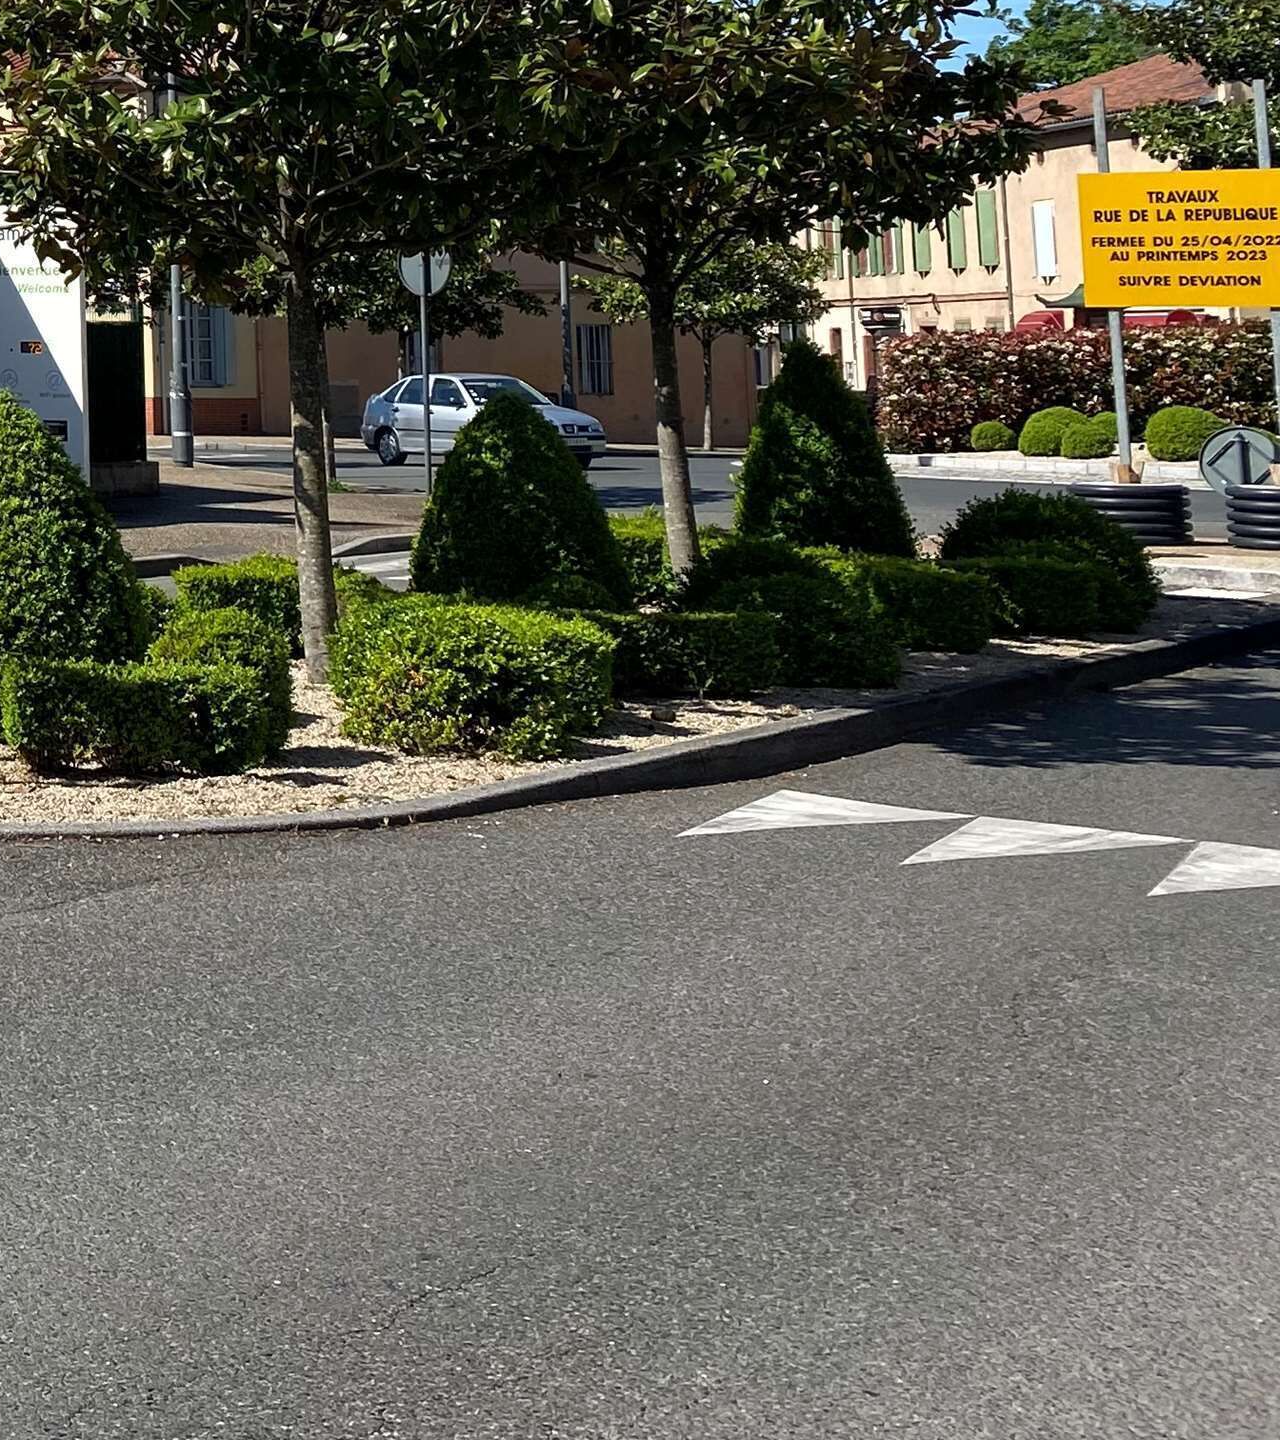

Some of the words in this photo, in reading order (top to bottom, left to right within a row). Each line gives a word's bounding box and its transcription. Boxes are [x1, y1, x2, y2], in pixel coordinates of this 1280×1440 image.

[1146, 190, 1219, 204] TRAVAUX
[1093, 210, 1122, 223] RUE
[1129, 209, 1149, 222] DE
[1156, 209, 1176, 222] LA
[1184, 207, 1278, 221] REPUBLIQUE
[1091, 236, 1145, 248] FERMEE
[1153, 236, 1174, 247] DU
[1181, 235, 1280, 247] 25/04/2022
[1110, 251, 1130, 261] AU
[1137, 250, 1219, 261] PRINTEMPS
[1227, 250, 1268, 261] 2023
[1118, 275, 1171, 286] SUIVRE
[1179, 275, 1261, 286] DEVIATION
[17, 283, 70, 294] Welcome
